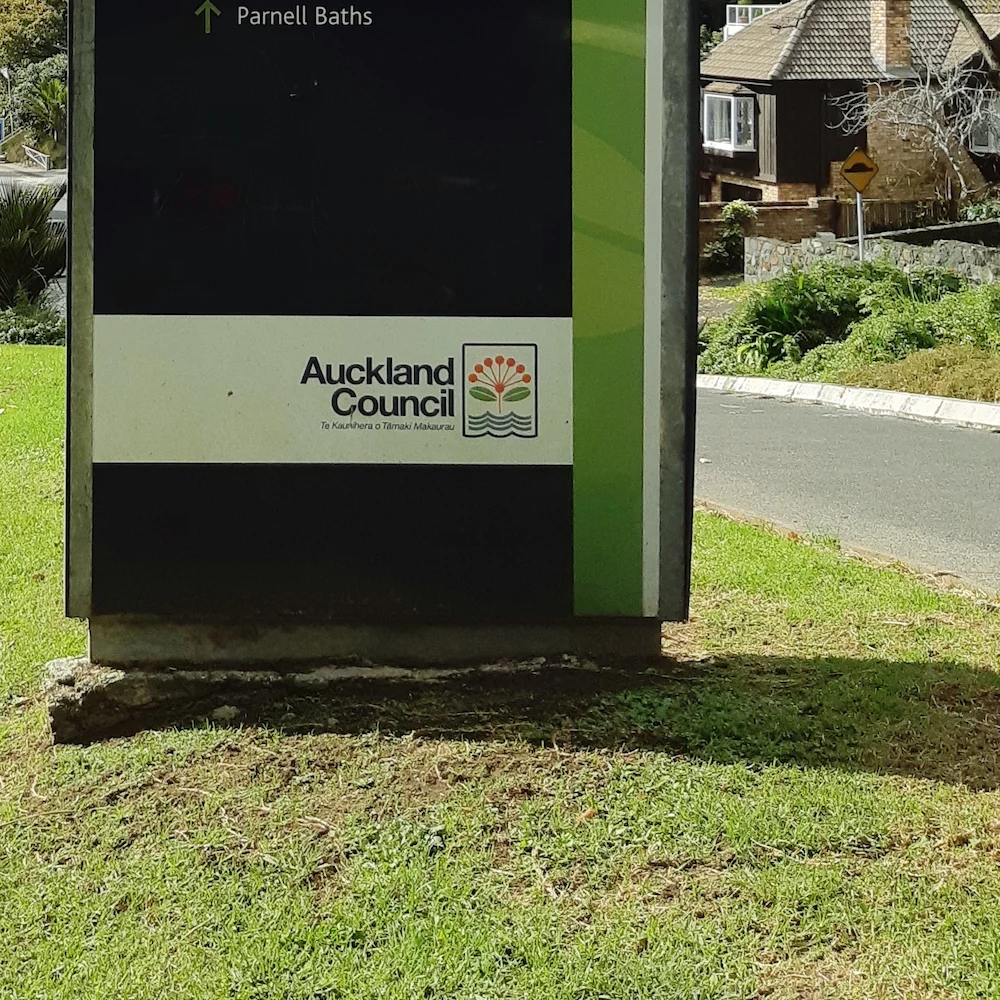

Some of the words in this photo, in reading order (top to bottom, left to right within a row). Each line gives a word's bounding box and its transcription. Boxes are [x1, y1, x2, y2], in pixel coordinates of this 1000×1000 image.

[236, 5, 308, 26] Parnell
[315, 5, 373, 26] Baths
[300, 356, 455, 386] Auckland
[331, 387, 455, 417] Council
[320, 421, 331, 430] Te
[413, 422, 456, 431] Makaurau
